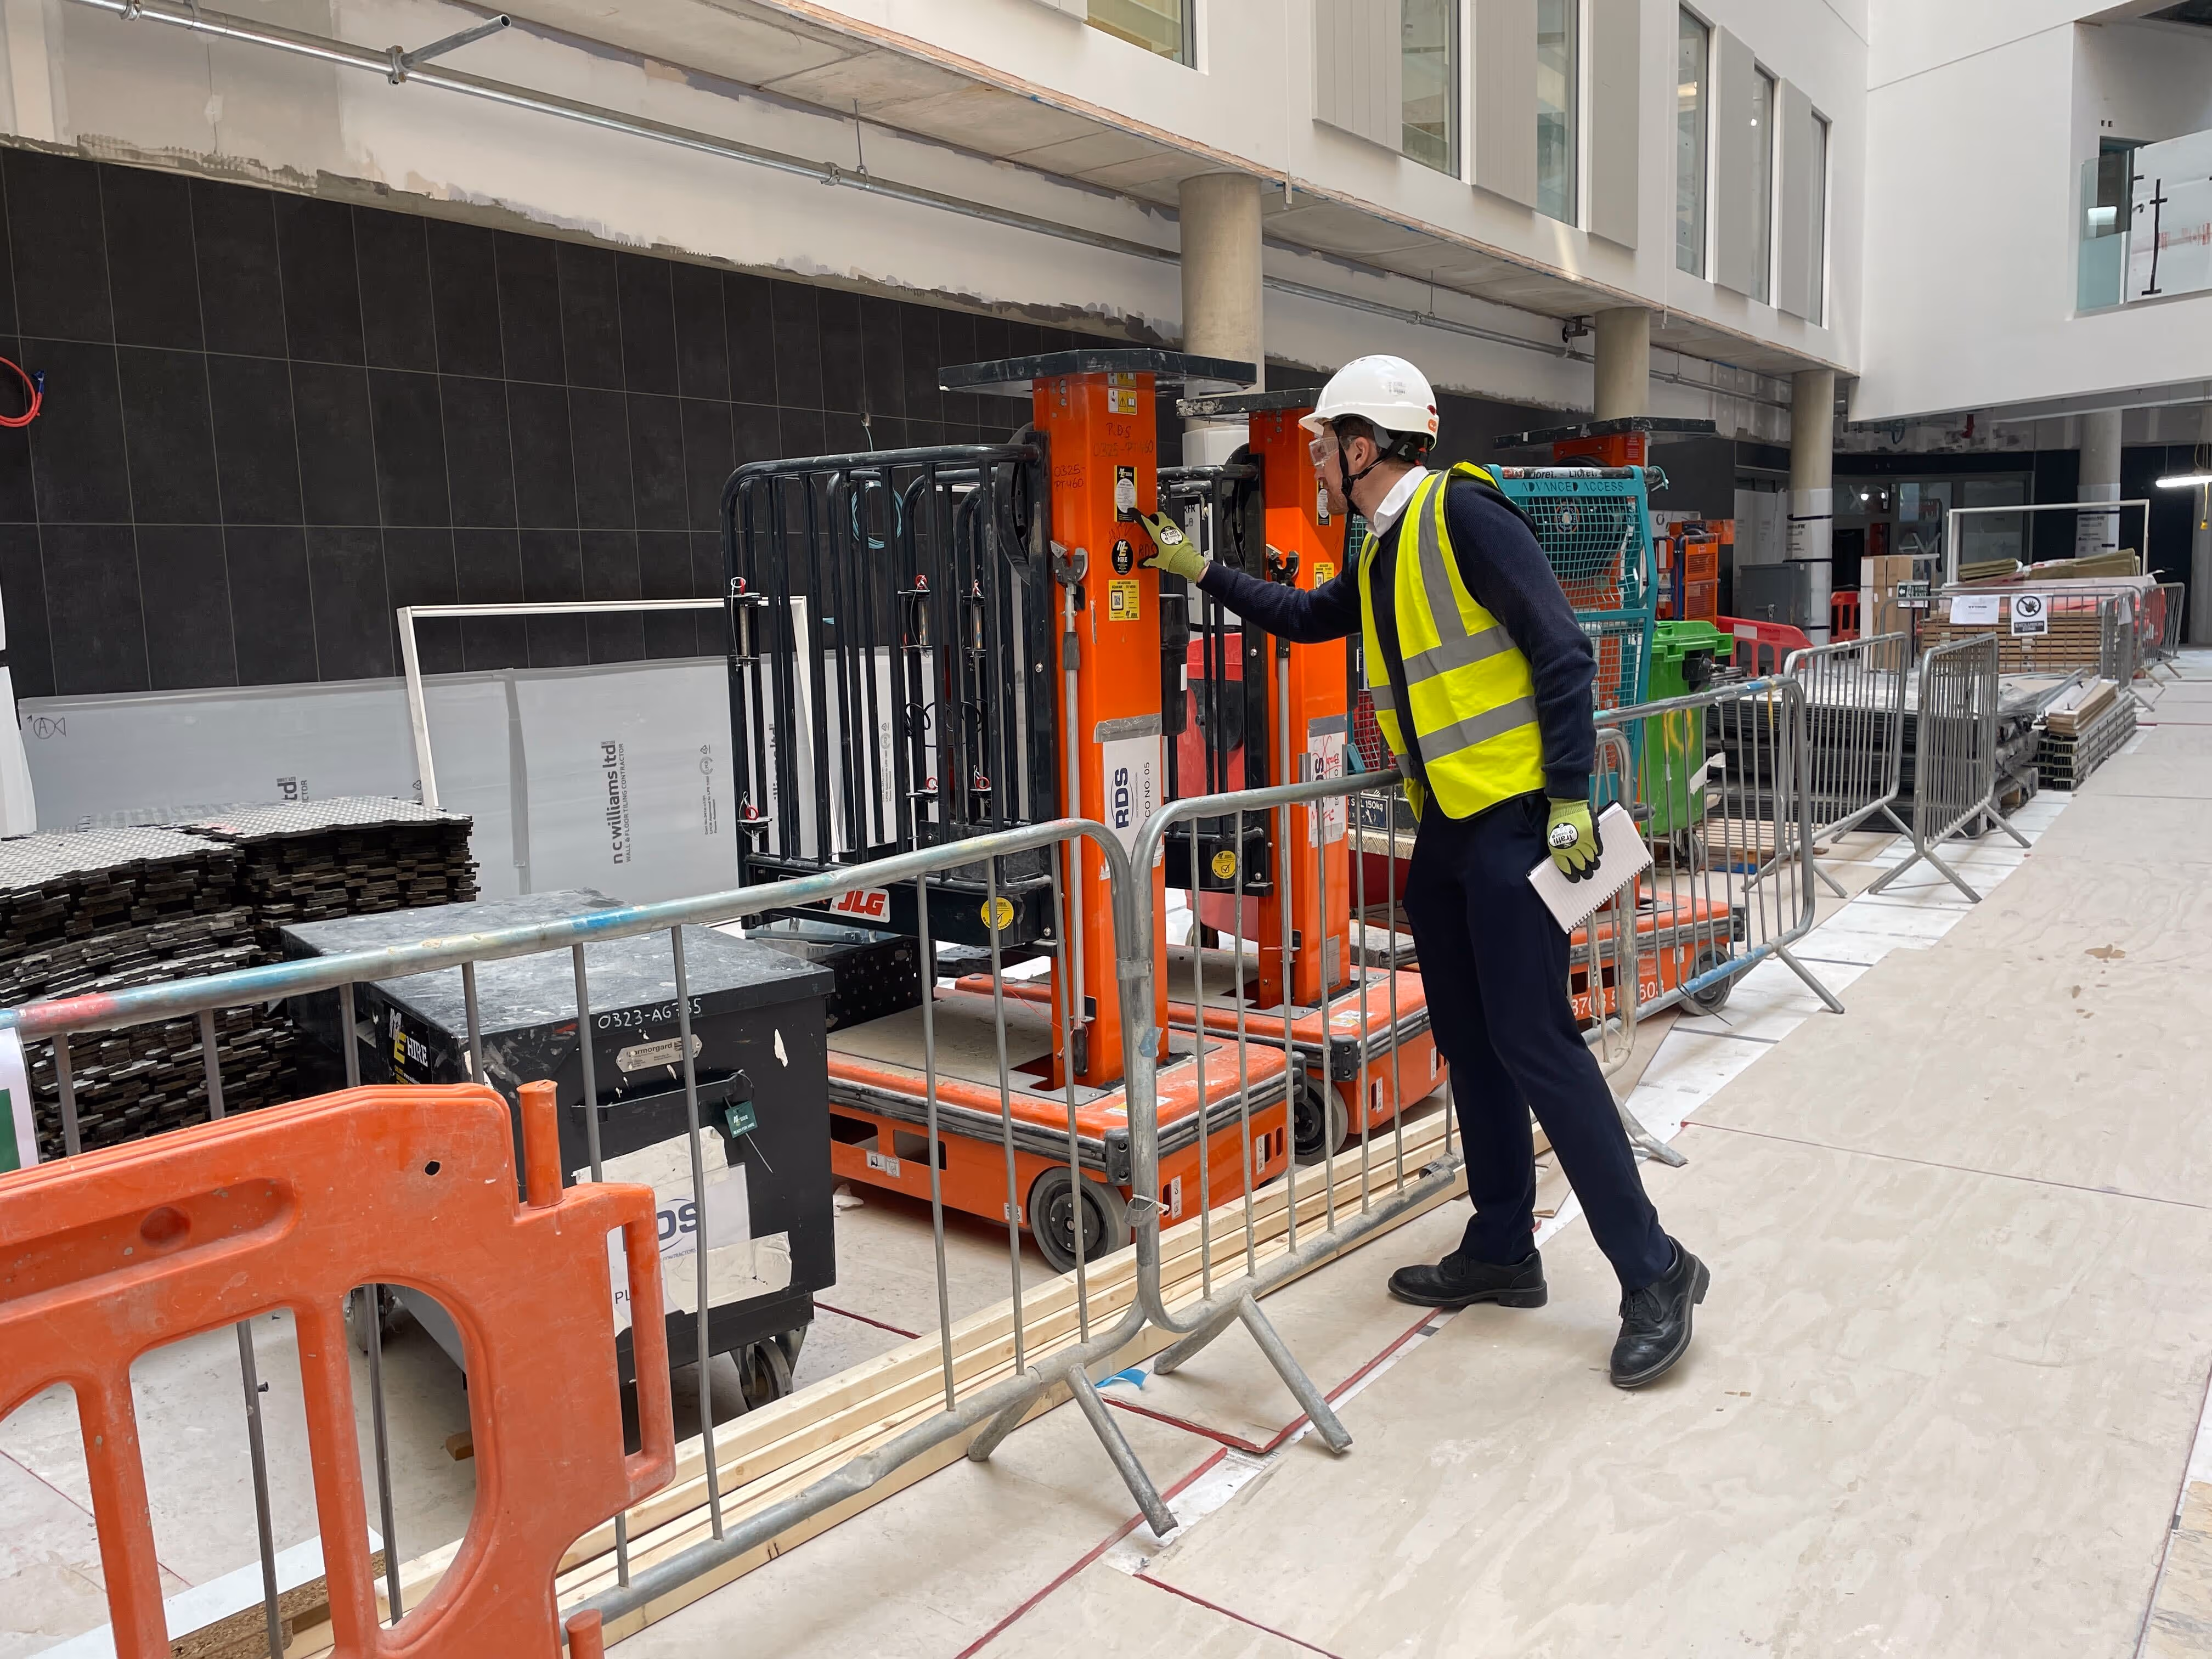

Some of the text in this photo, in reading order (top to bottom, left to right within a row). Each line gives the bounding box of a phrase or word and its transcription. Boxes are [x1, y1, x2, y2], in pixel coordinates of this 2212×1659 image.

[1106, 422, 1131, 438] RDS
[1522, 482, 1624, 492] ADVANCED ACCESS
[601, 744, 617, 768] ltd
[618, 743, 627, 789] CONTRACTOR
[1144, 762, 1150, 775] 05
[606, 770, 622, 839] williams
[1114, 768, 1129, 829] RDS
[1351, 798, 1383, 812] SL 150kg
[612, 841, 622, 851] c
[613, 853, 623, 864] n
[837, 890, 887, 917] JLG
[407, 1036, 428, 1067] HIRE
[633, 1042, 672, 1056] armorgard
[657, 1202, 697, 1242] DS
